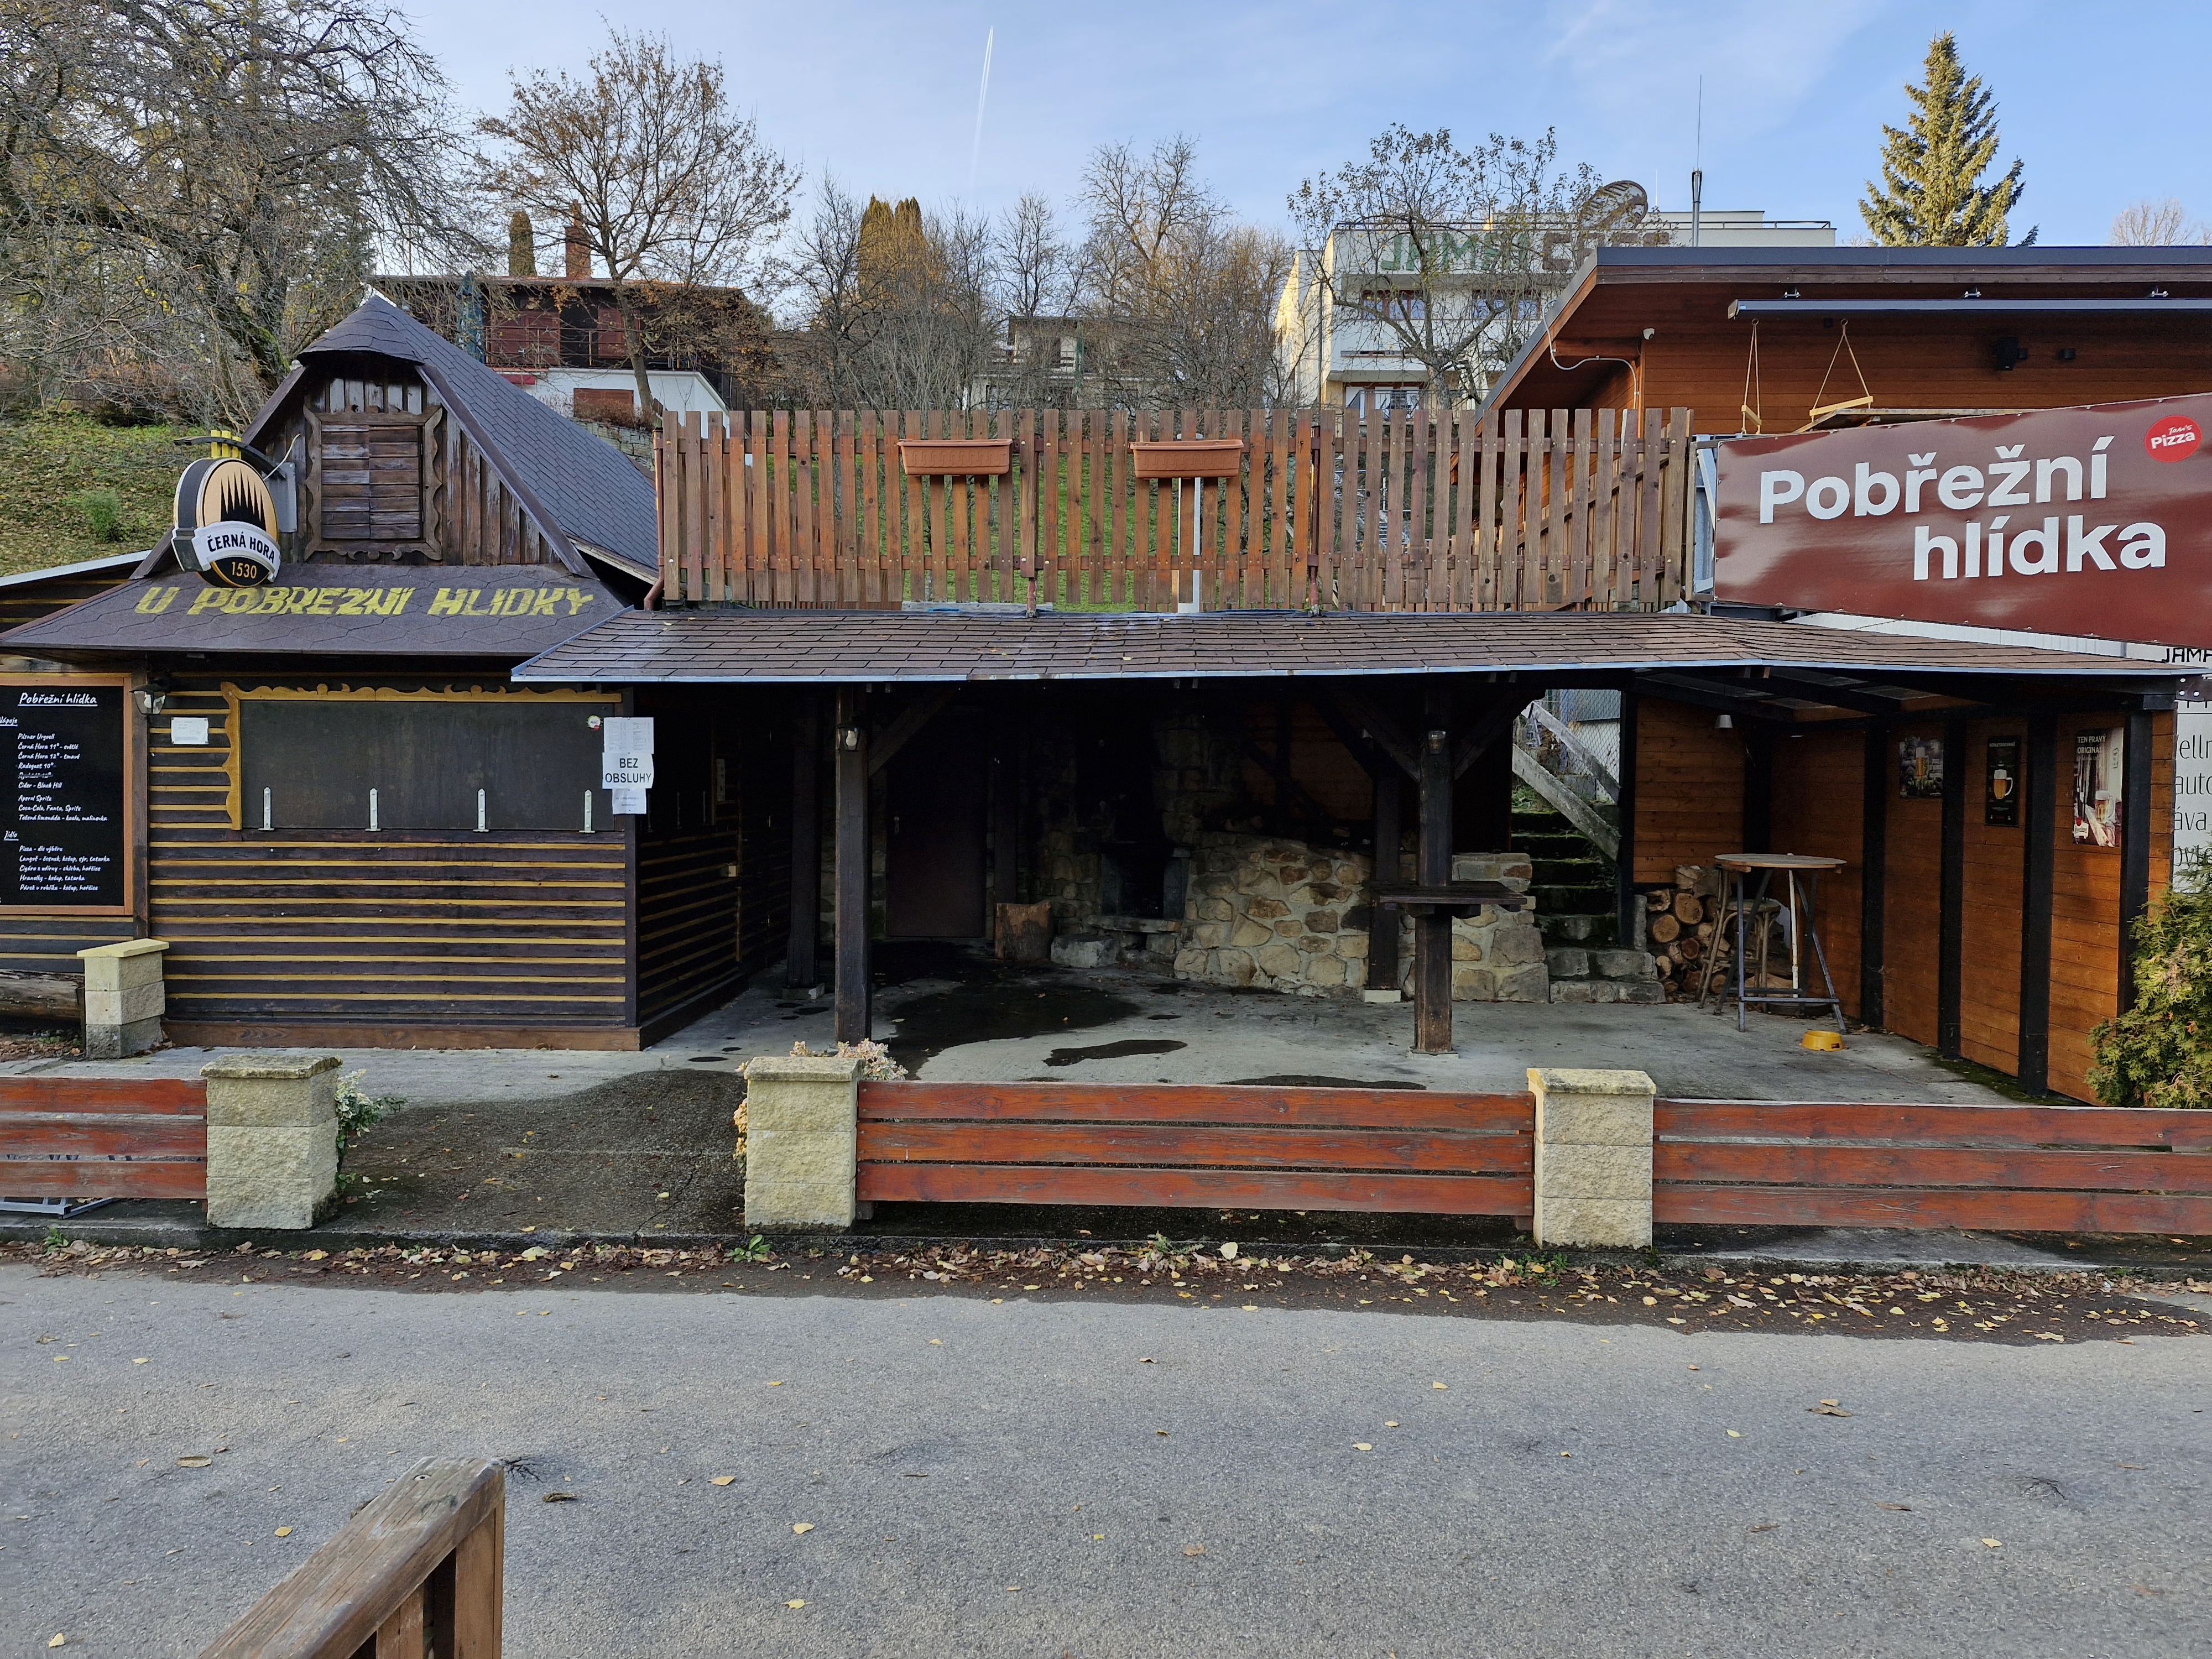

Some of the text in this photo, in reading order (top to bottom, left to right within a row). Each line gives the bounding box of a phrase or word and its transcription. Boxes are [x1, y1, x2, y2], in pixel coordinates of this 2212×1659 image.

[2168, 424, 2193, 435] Tom's
[2151, 432, 2195, 450] Pizza
[1760, 436, 2115, 524] Pobřežní
[207, 531, 275, 564] ČERNÁ HORA
[1914, 515, 2166, 581] hlídka
[232, 561, 257, 579] 1530
[134, 587, 181, 614] U
[19, 692, 97, 705] Pobřežní hlídka
[2177, 734, 2212, 759] ell
[619, 758, 639, 768] BEZ
[605, 773, 652, 784] OBSLUHY
[4, 831, 18, 839] Jídlo
